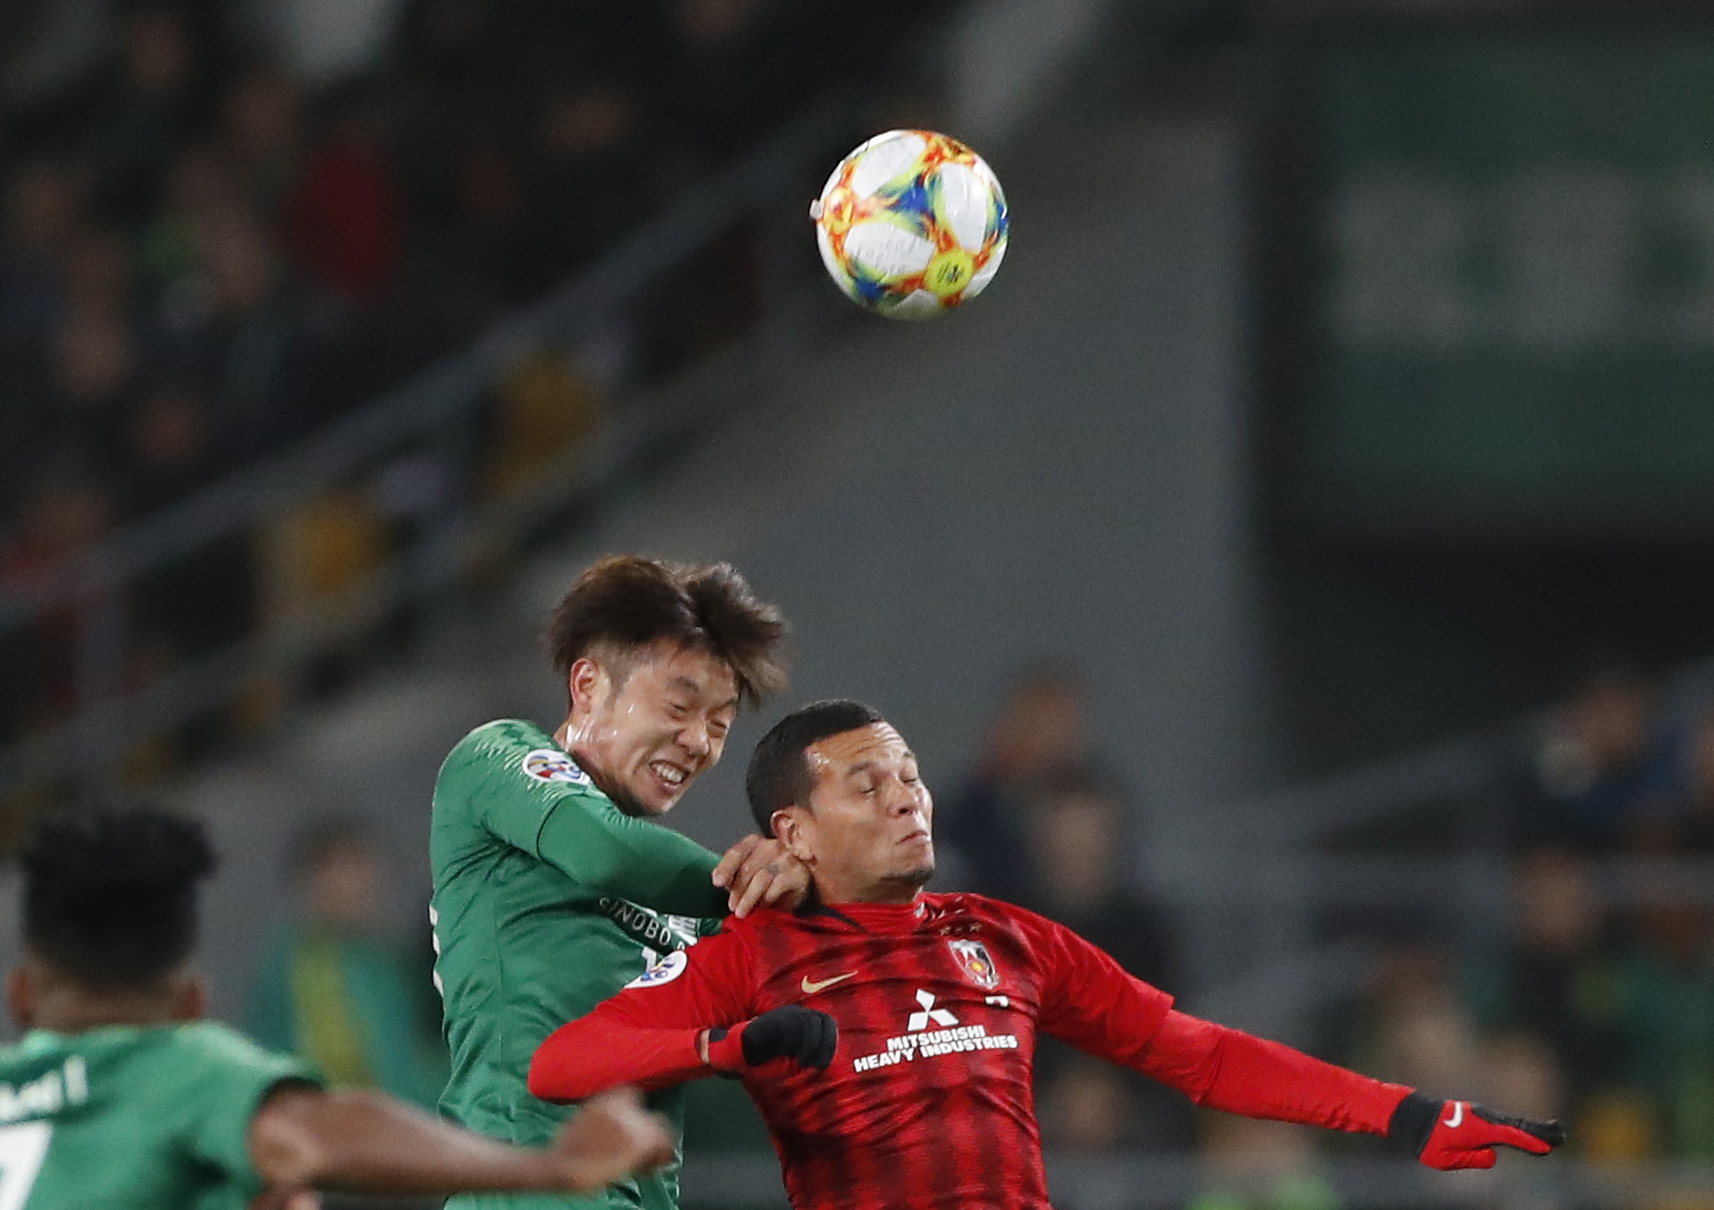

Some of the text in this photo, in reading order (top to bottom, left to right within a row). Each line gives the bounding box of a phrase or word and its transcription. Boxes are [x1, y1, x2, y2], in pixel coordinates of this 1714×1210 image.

[853, 1034, 1018, 1073] HEAVY INDUSTRIES
[886, 1024, 986, 1051] MITSUBISHI
